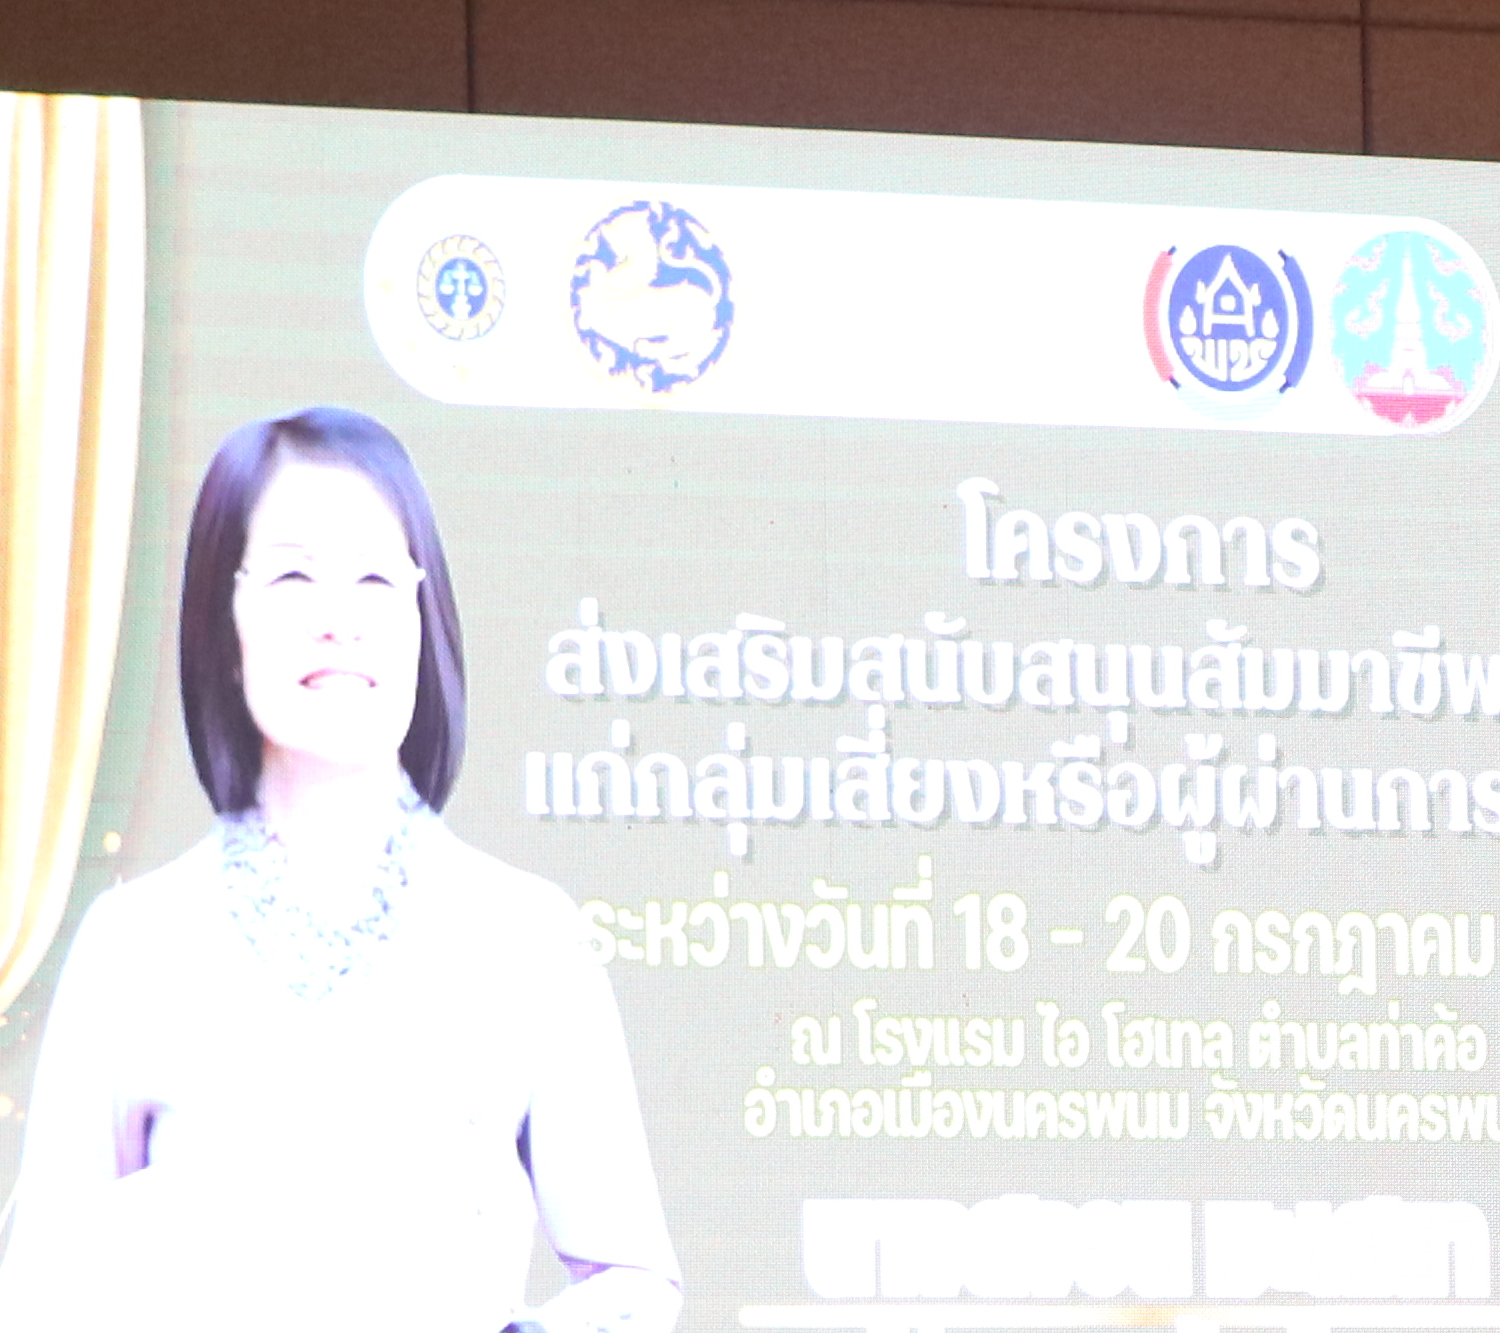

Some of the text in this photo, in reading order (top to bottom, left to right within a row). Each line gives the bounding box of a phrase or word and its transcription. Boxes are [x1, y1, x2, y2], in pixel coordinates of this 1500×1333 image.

[956, 478, 1320, 588] โครงการ
[579, 855, 933, 972] ระหว่างวันที่
[954, 895, 1029, 971] 18
[1105, 896, 1190, 973] 20
[1212, 909, 1495, 995] กรกฎาคม
[791, 1000, 1488, 1071] ณ โรงแรม ไอ โฮเทล ตำบลท่าค้อ
[744, 1066, 1190, 1139] อำเภอเมืองนครพนม
